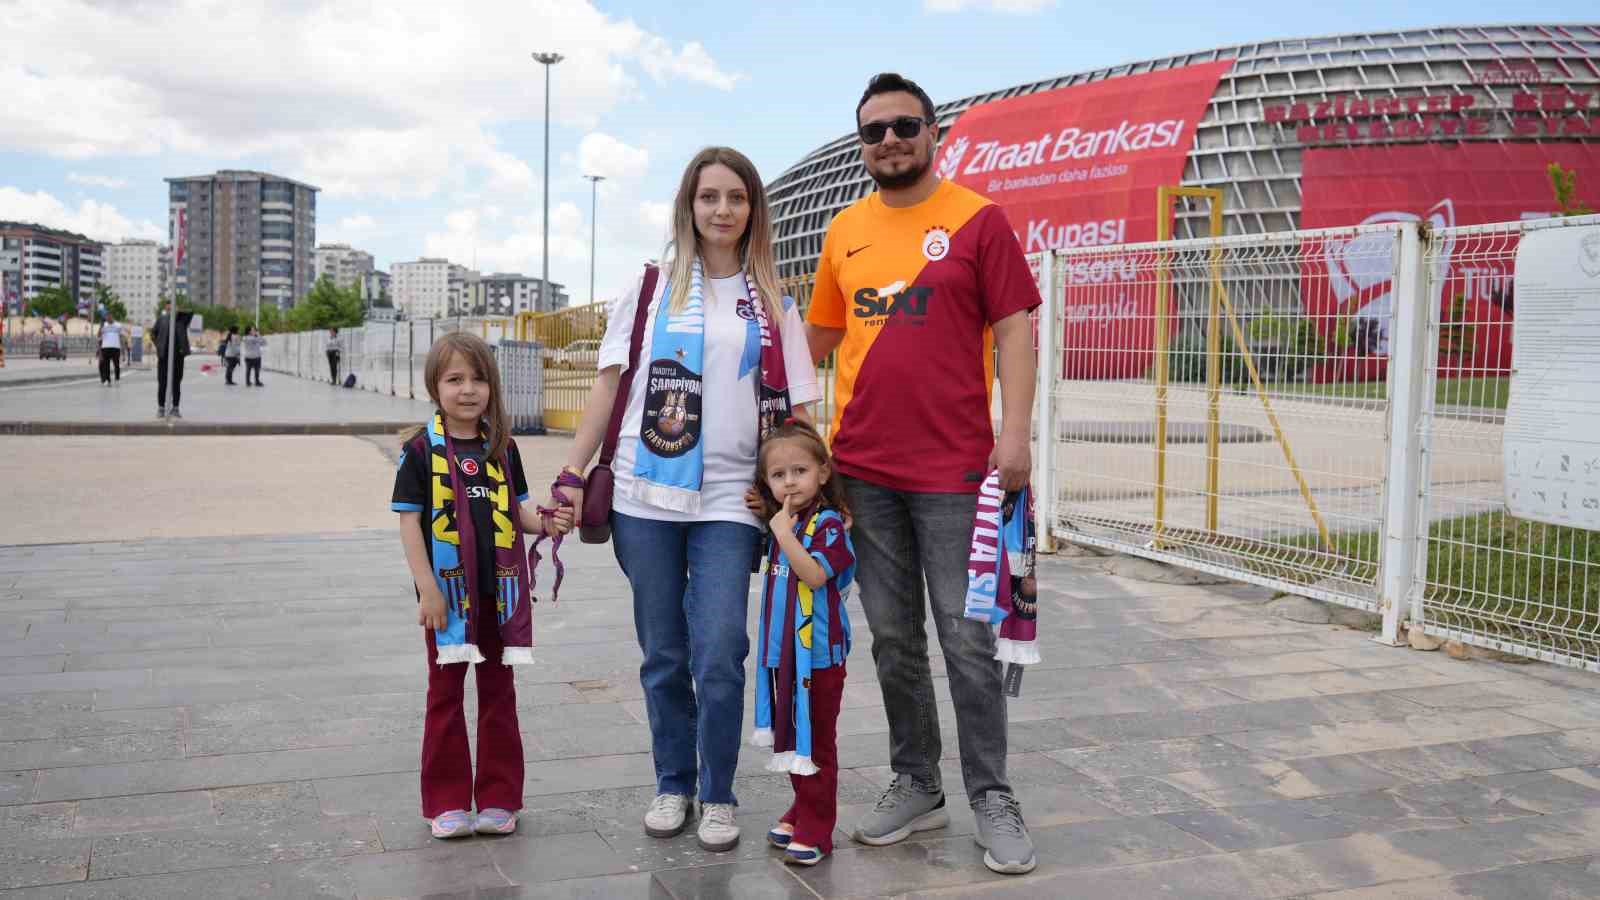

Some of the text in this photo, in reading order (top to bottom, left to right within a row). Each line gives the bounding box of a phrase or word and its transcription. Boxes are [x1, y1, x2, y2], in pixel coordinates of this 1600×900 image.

[964, 119, 1185, 176] Ziraat Bankası
[987, 180, 1002, 192] Bir
[1003, 173, 1057, 190] bankadan
[1058, 169, 1088, 183] daha
[1026, 219, 1126, 251] Kupası
